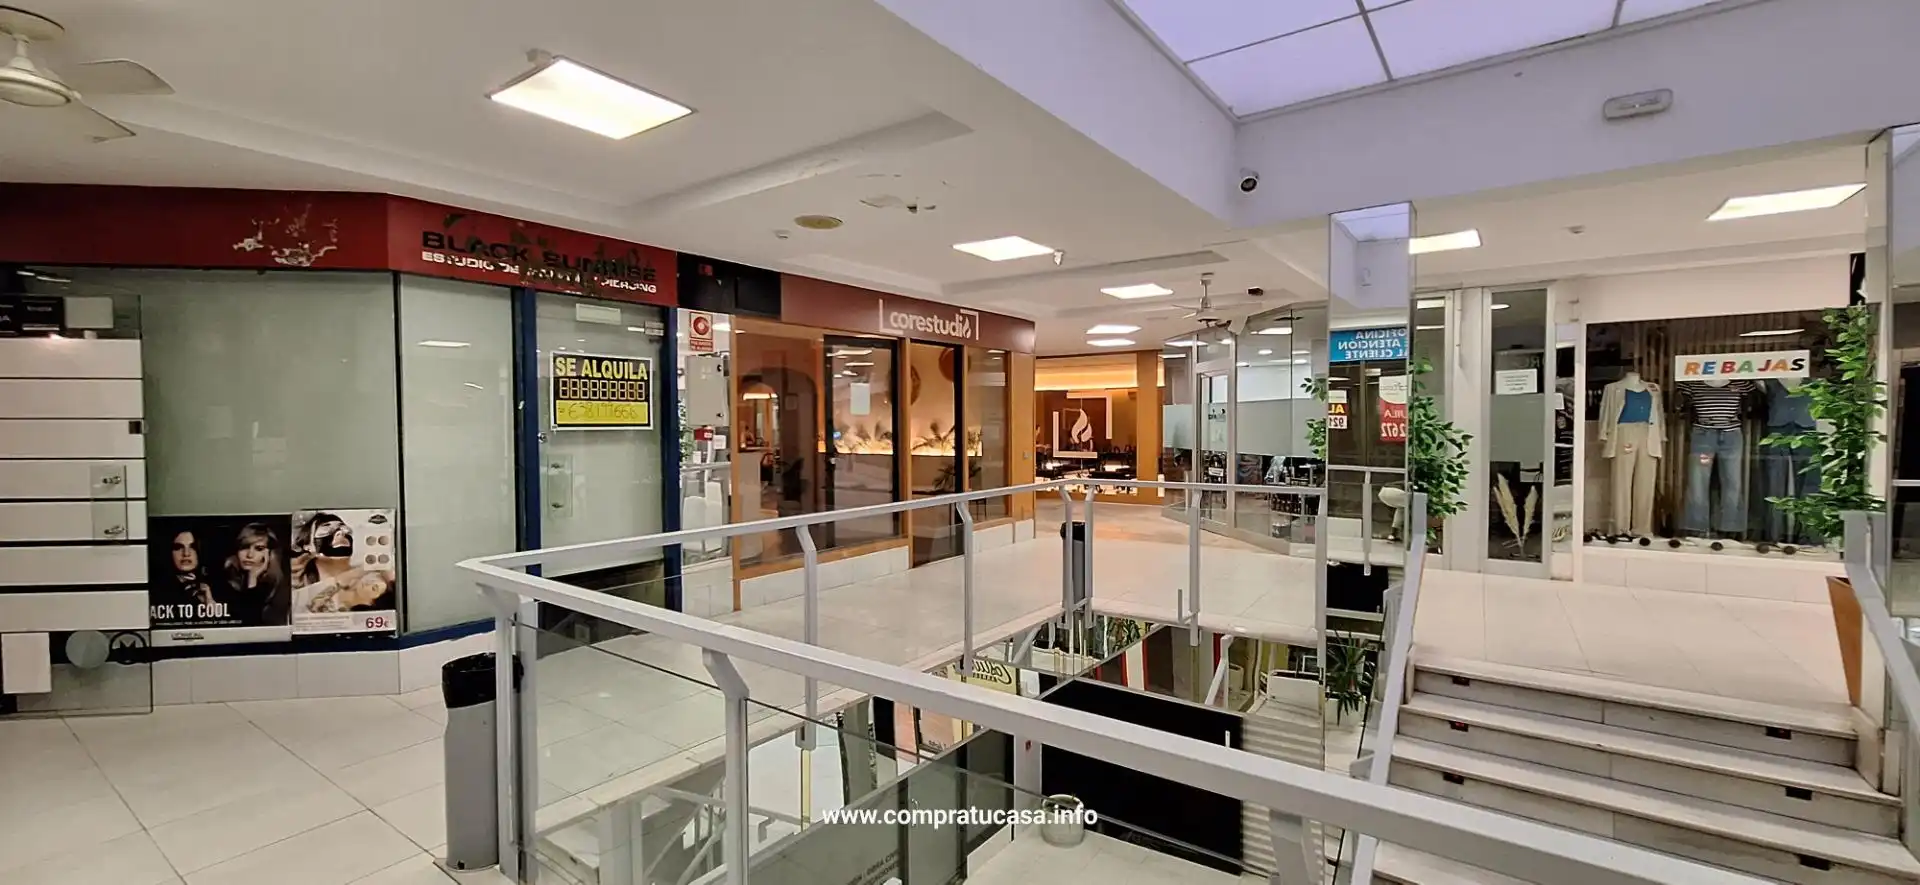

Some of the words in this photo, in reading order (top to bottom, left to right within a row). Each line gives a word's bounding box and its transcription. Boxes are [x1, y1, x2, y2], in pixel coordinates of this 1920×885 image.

[555, 357, 576, 377] SE
[581, 359, 648, 380] ALQUILA
[1683, 357, 1805, 376] REBAJAS
[178, 603, 194, 618] TO
[197, 602, 231, 619] COOL
